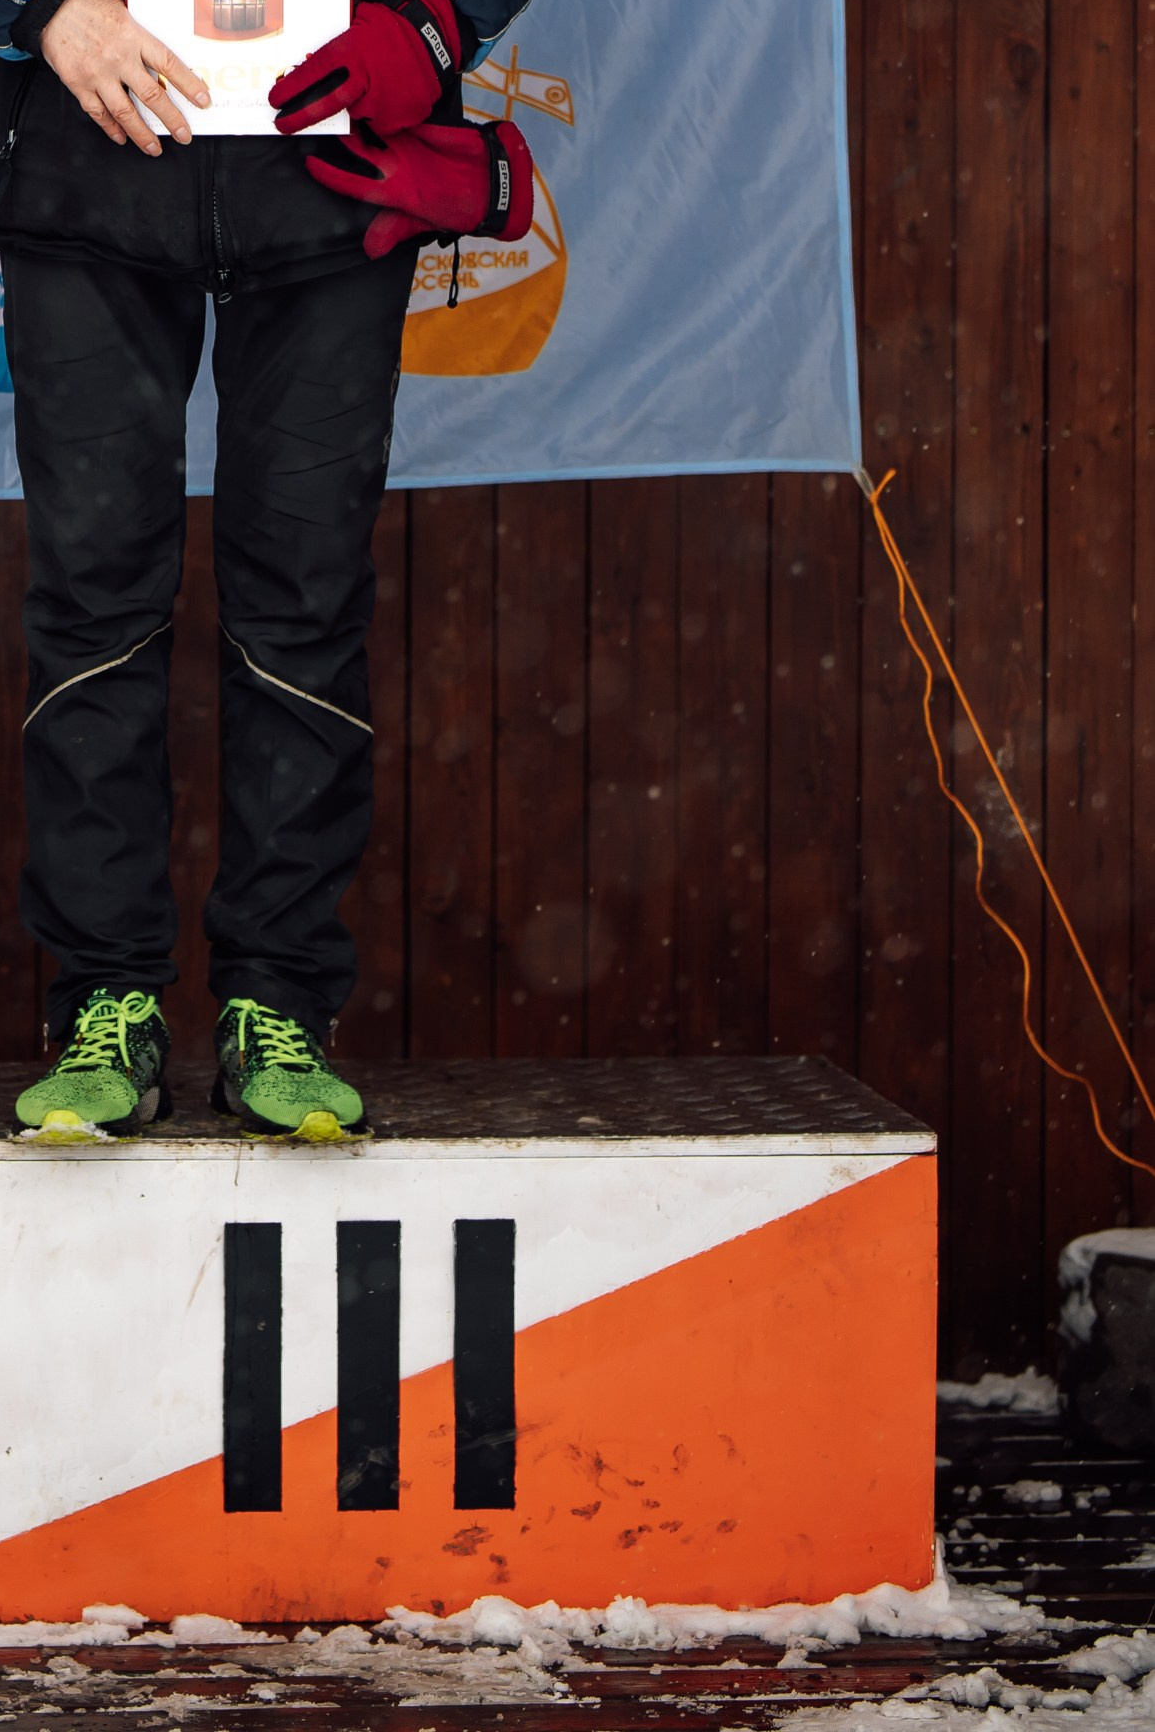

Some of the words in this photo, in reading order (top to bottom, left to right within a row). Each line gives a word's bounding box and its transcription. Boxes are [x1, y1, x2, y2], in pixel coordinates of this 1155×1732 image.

[424, 26, 450, 66] SPORT
[500, 162, 508, 209] SPORT
[223, 1220, 515, 1512] III
